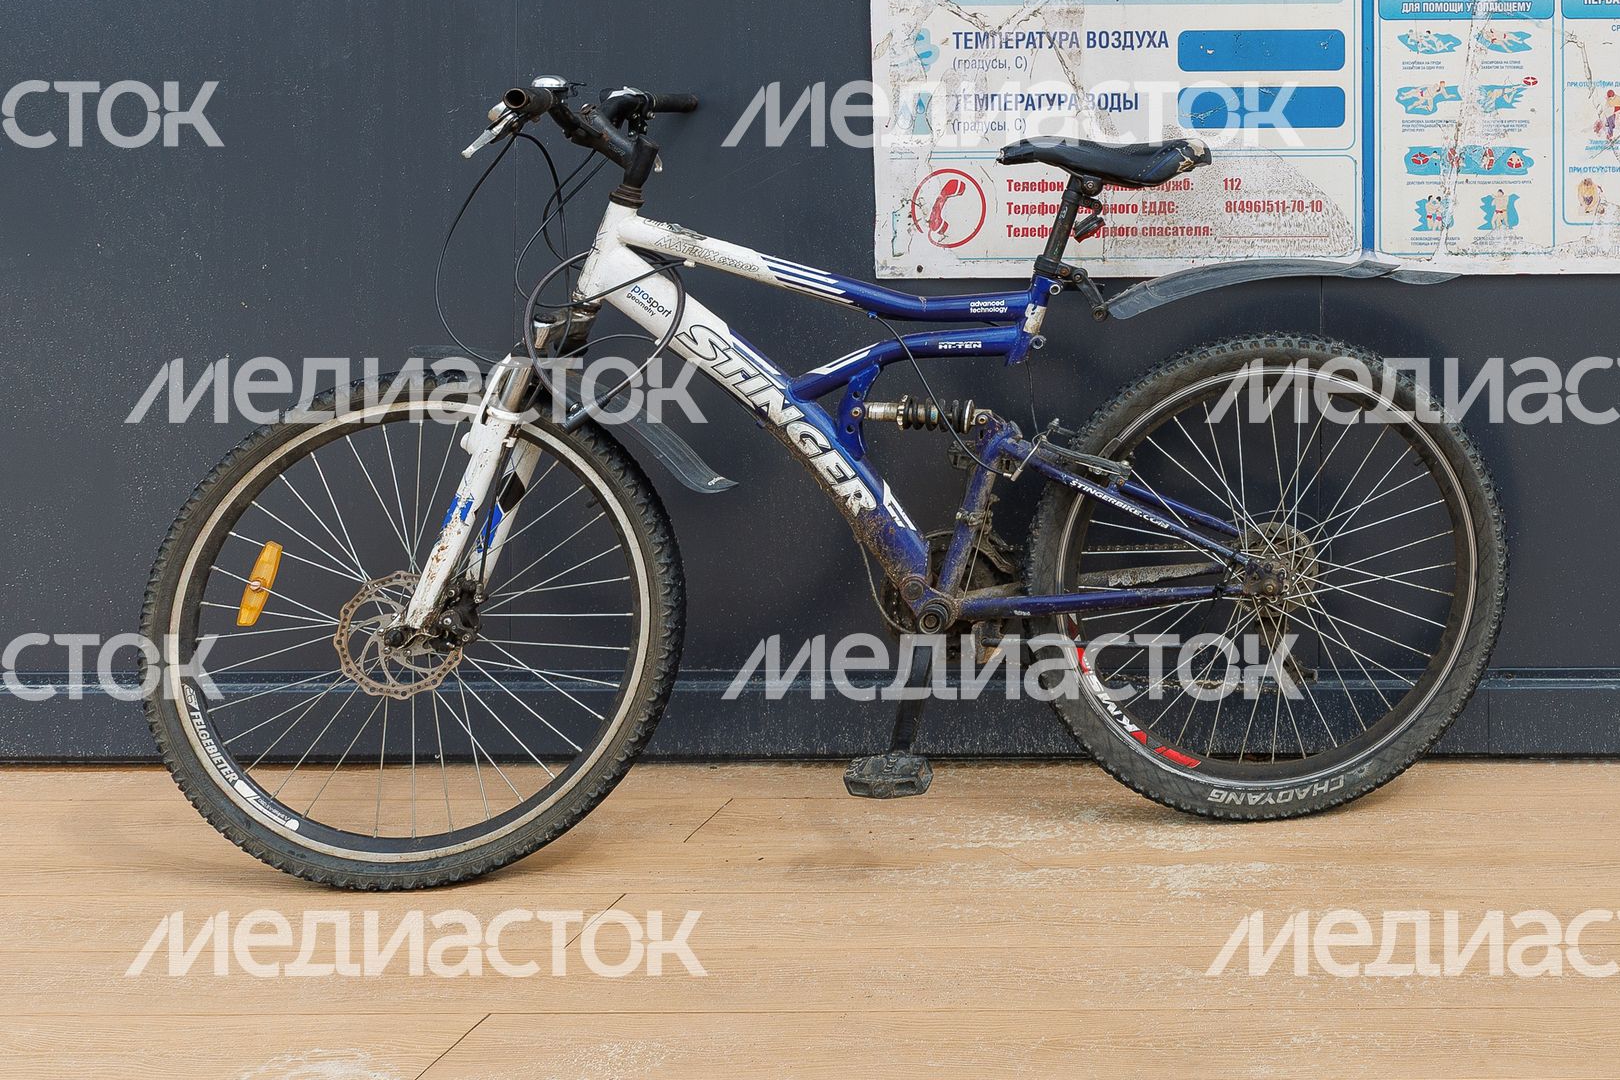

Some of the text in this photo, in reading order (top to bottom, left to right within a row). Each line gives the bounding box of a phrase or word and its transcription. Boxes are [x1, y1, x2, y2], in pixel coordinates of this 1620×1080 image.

[1402, 2, 1421, 14] ДЛЯ
[1422, 2, 1464, 14] ПОМОЩИ
[952, 30, 1169, 51] ТЕМПЕРАТУРА ВОЗДУХА
[952, 56, 1011, 71] (градусы,
[1085, 92, 1139, 113] ВОДЫ
[1006, 179, 1064, 193] Телефон
[1223, 178, 1241, 191] 112
[1141, 201, 1179, 216] ЕДДС:
[1225, 200, 1323, 214] 8(496)511-70-10
[1141, 224, 1213, 238] спасателя:
[655, 235, 720, 262] MATRIX
[626, 291, 656, 317] geometry
[630, 284, 672, 318] prosport
[969, 306, 1008, 314] technology
[675, 323, 877, 518] STINGER
[189, 711, 239, 786] FELGEBIETER
[1207, 774, 1346, 806] CHAOYANG
